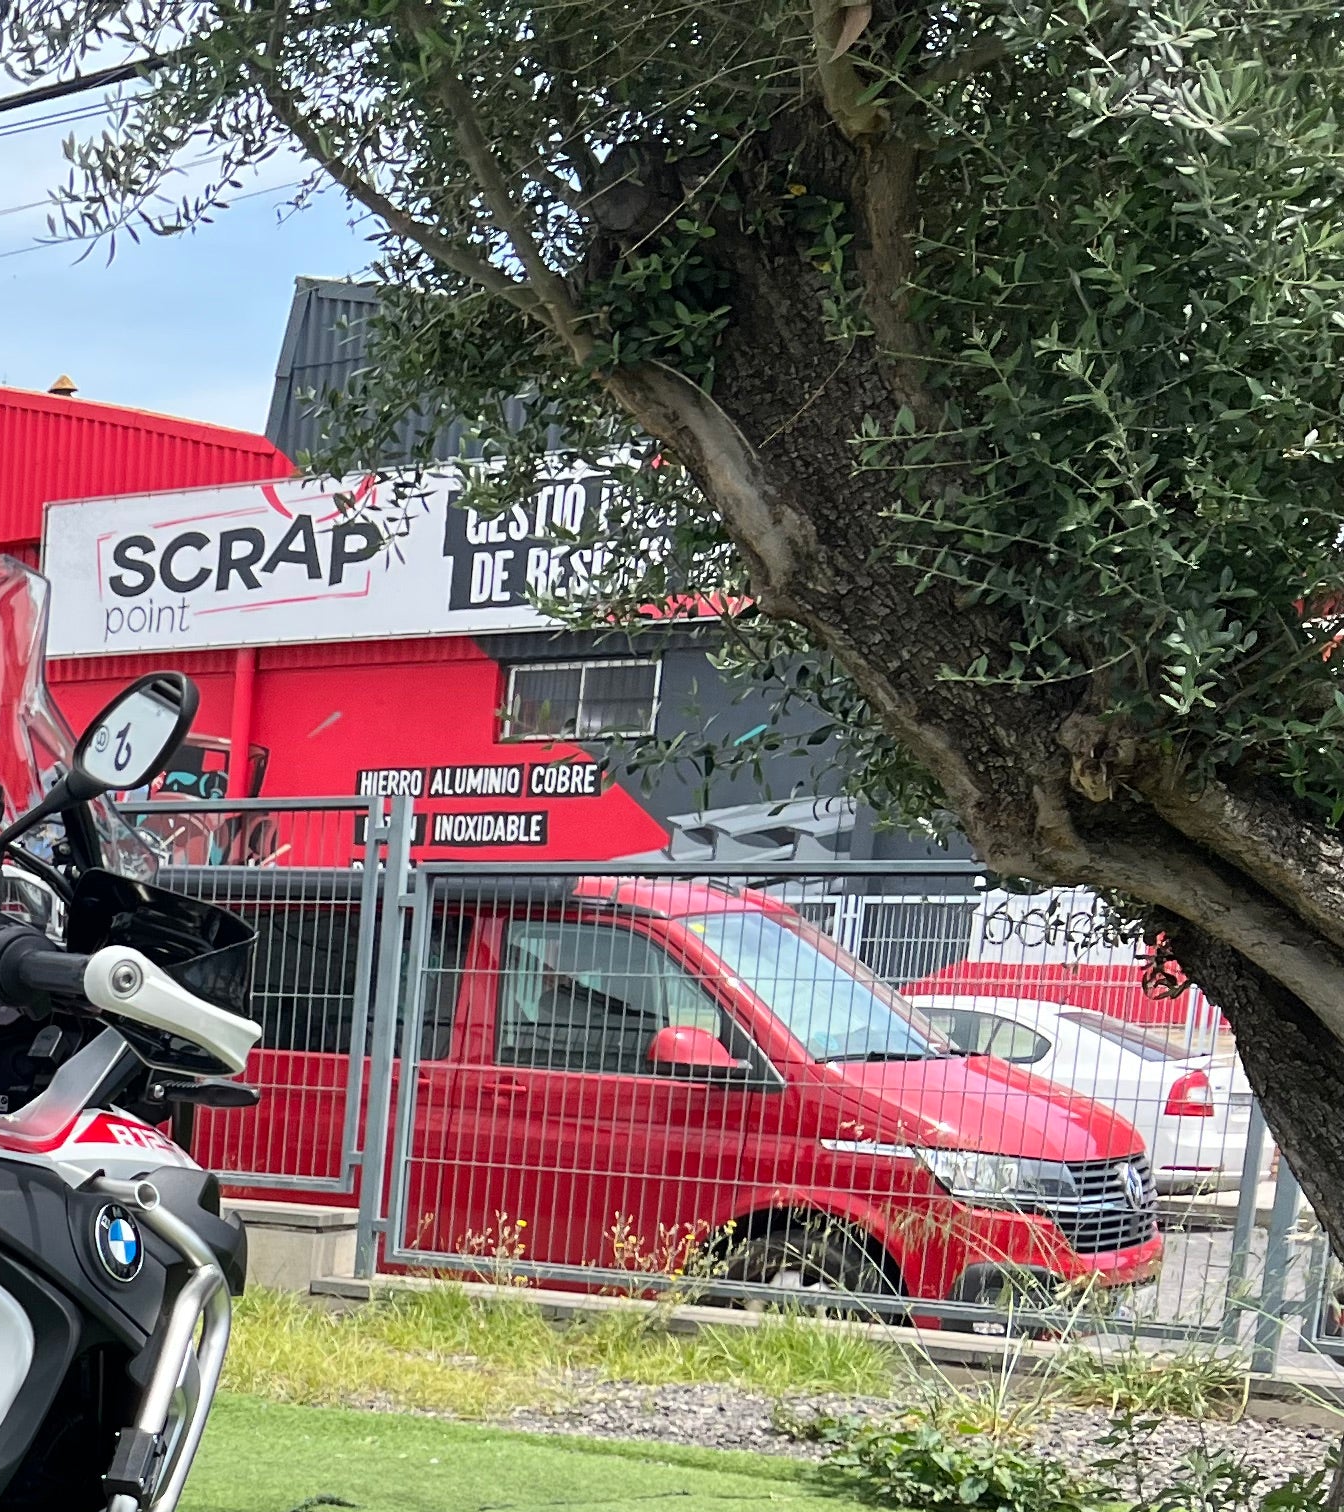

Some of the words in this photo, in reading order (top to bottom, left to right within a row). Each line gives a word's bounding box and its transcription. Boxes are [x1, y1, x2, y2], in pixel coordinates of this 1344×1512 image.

[109, 514, 384, 597] SCRAP
[470, 550, 515, 604] DE
[104, 597, 190, 642] point
[360, 770, 423, 797] HIERRO
[430, 767, 521, 796] ALUMINIO
[530, 764, 598, 794] COBRE
[434, 814, 543, 842] INOXIDABLE
